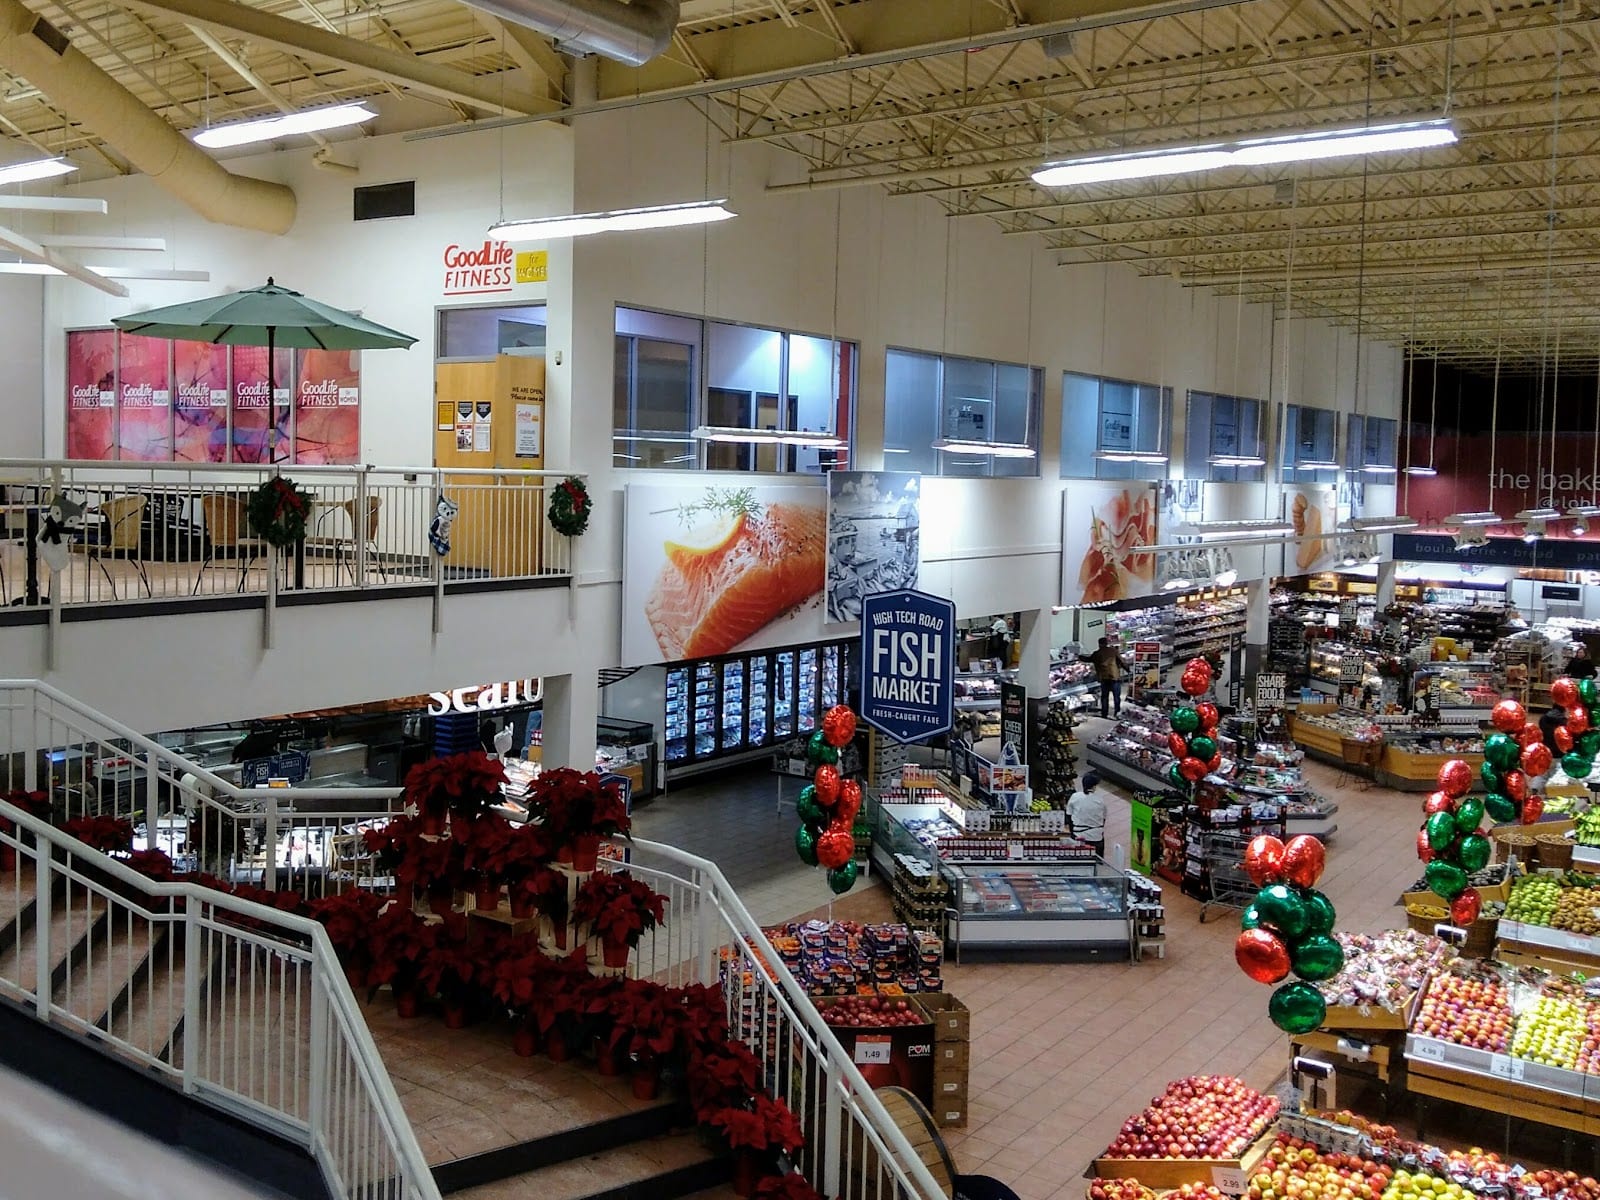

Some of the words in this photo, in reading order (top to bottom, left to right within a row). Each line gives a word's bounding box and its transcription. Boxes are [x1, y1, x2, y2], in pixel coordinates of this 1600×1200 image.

[444, 240, 513, 268] GoodLife
[445, 266, 511, 288] FITNESS
[73, 397, 99, 407] FITNESS
[123, 397, 152, 407] FITNESS
[179, 396, 209, 407] FITNESS
[237, 395, 270, 406] FITNESS
[302, 394, 337, 406] FITNESS
[1488, 467, 1531, 490] the
[872, 610, 893, 625] HIGH
[895, 610, 917, 624] TECH
[918, 613, 944, 631] ROAD
[872, 628, 942, 680] FISH
[1258, 675, 1286, 688] SHARE
[872, 675, 941, 706] MARKET
[1258, 688, 1278, 699] FOOD
[872, 708, 921, 723] FRESH-CAUGHT
[256, 766, 269, 777] FISH
[865, 1050, 880, 1058] 1.49
[908, 1044, 931, 1054] POM
[1223, 1179, 1240, 1189] 2.99
